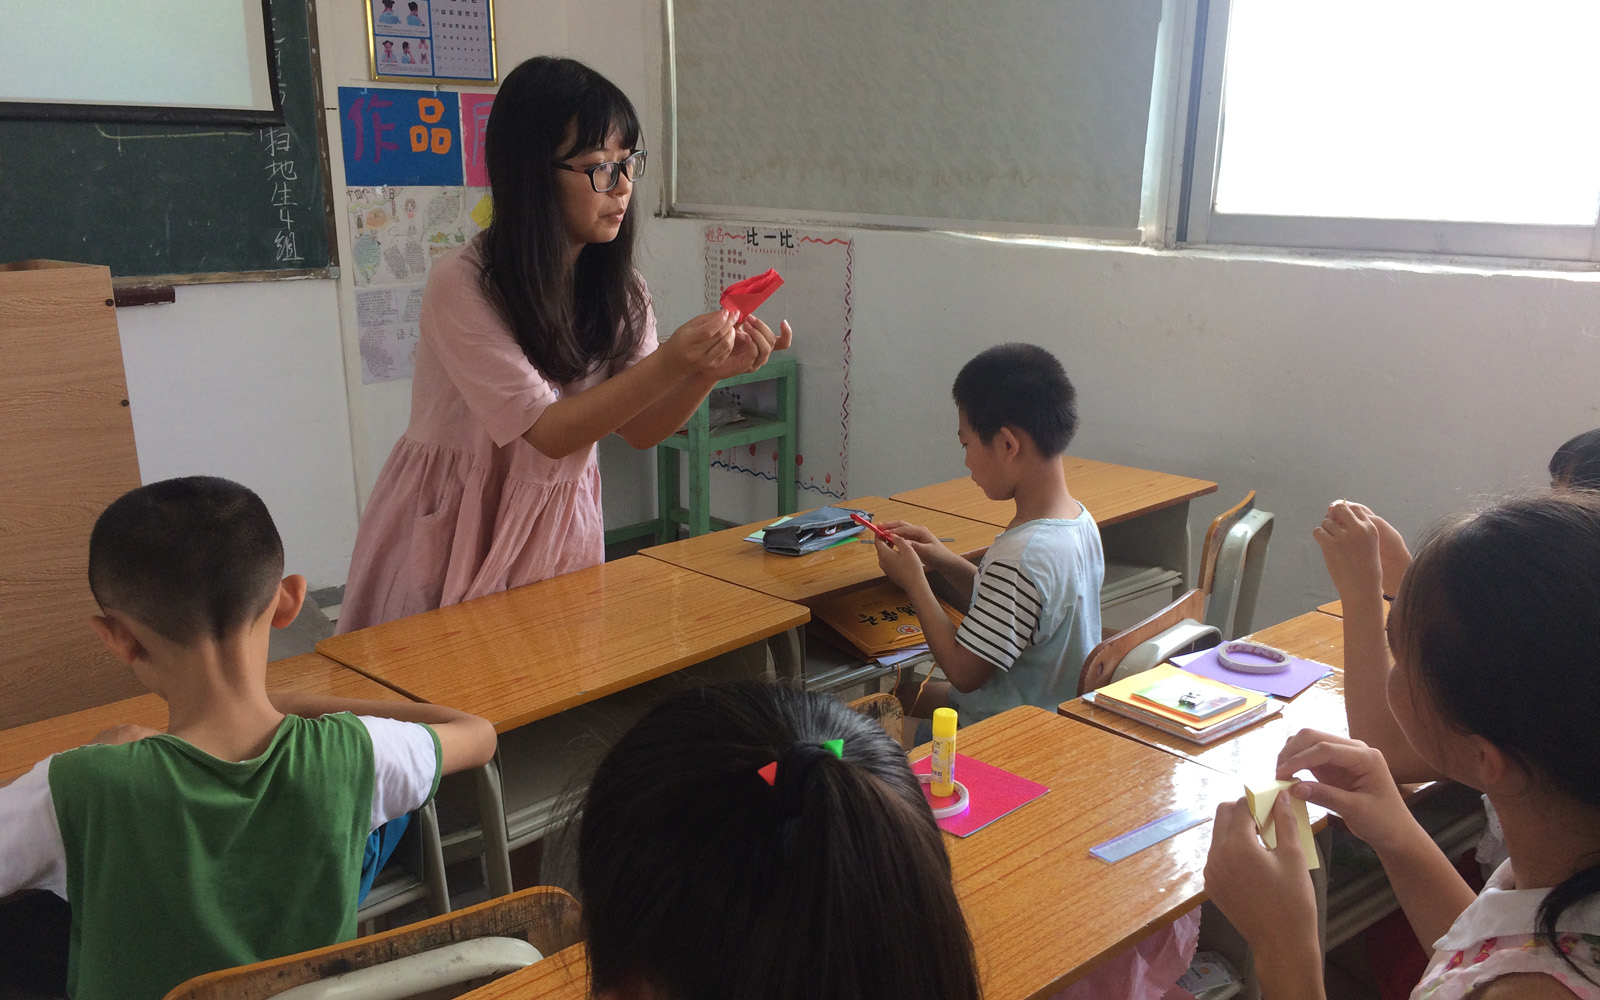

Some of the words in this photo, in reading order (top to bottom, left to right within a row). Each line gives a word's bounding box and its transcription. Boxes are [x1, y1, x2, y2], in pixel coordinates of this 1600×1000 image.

[347, 94, 452, 164] 作品
[746, 226, 795, 249] 比一比
